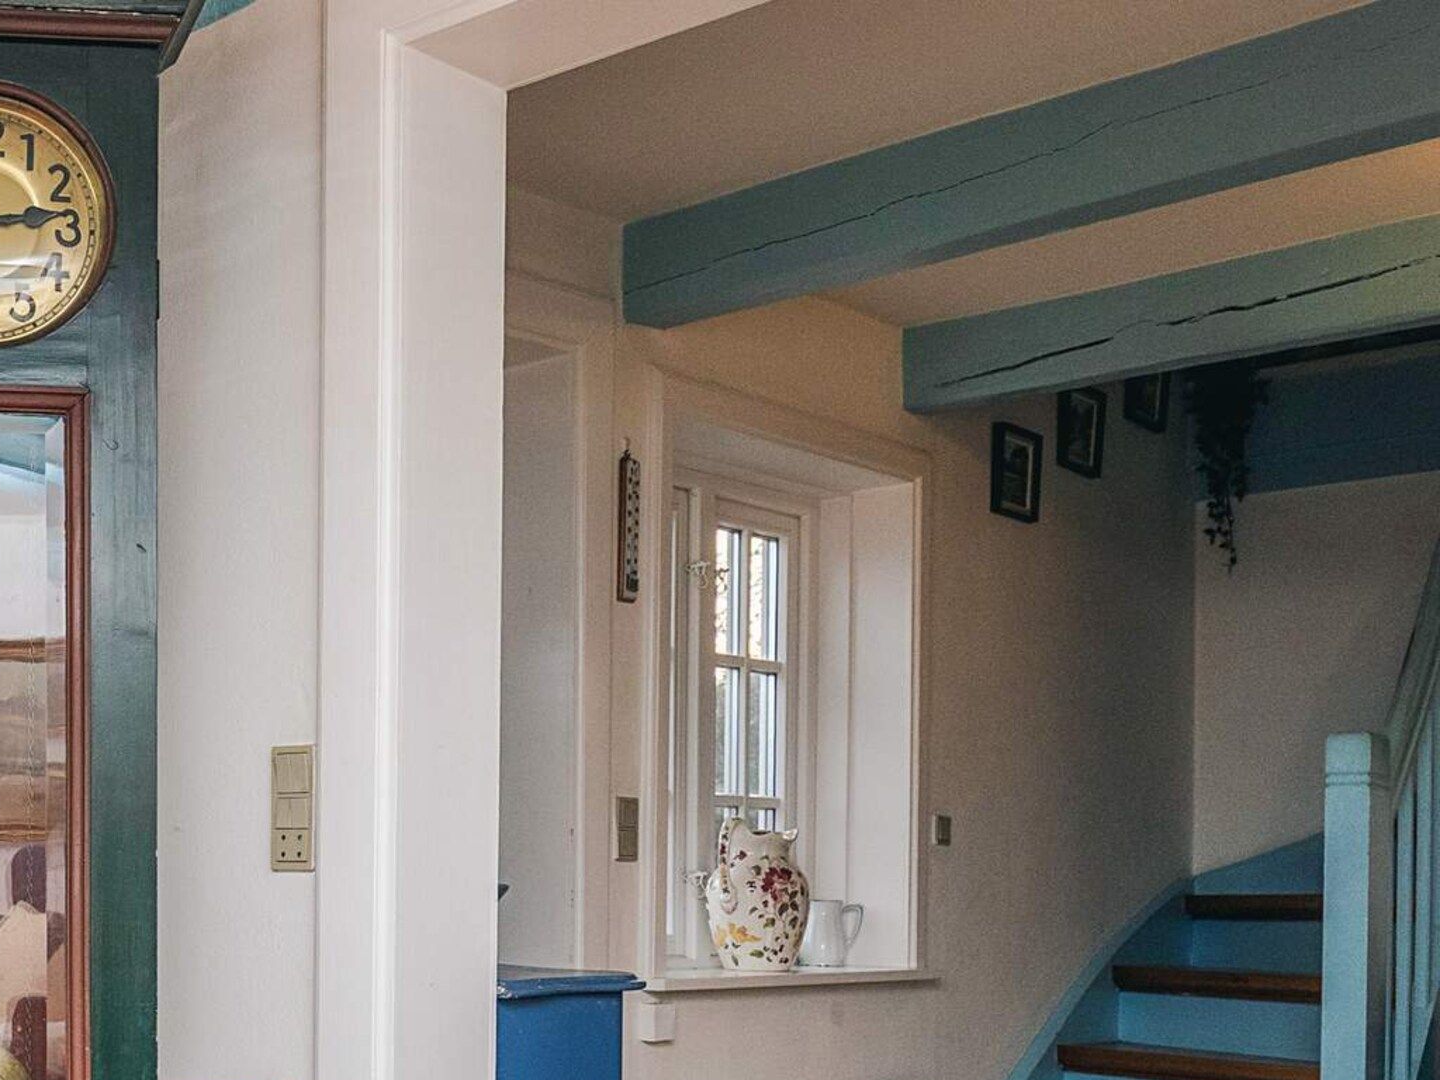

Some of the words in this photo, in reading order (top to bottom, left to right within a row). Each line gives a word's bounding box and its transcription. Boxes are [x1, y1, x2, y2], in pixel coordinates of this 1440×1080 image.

[20, 133, 35, 171] 1
[48, 163, 71, 203] 2
[54, 208, 81, 248] 3
[40, 252, 70, 292] 4
[10, 283, 36, 323] 5
